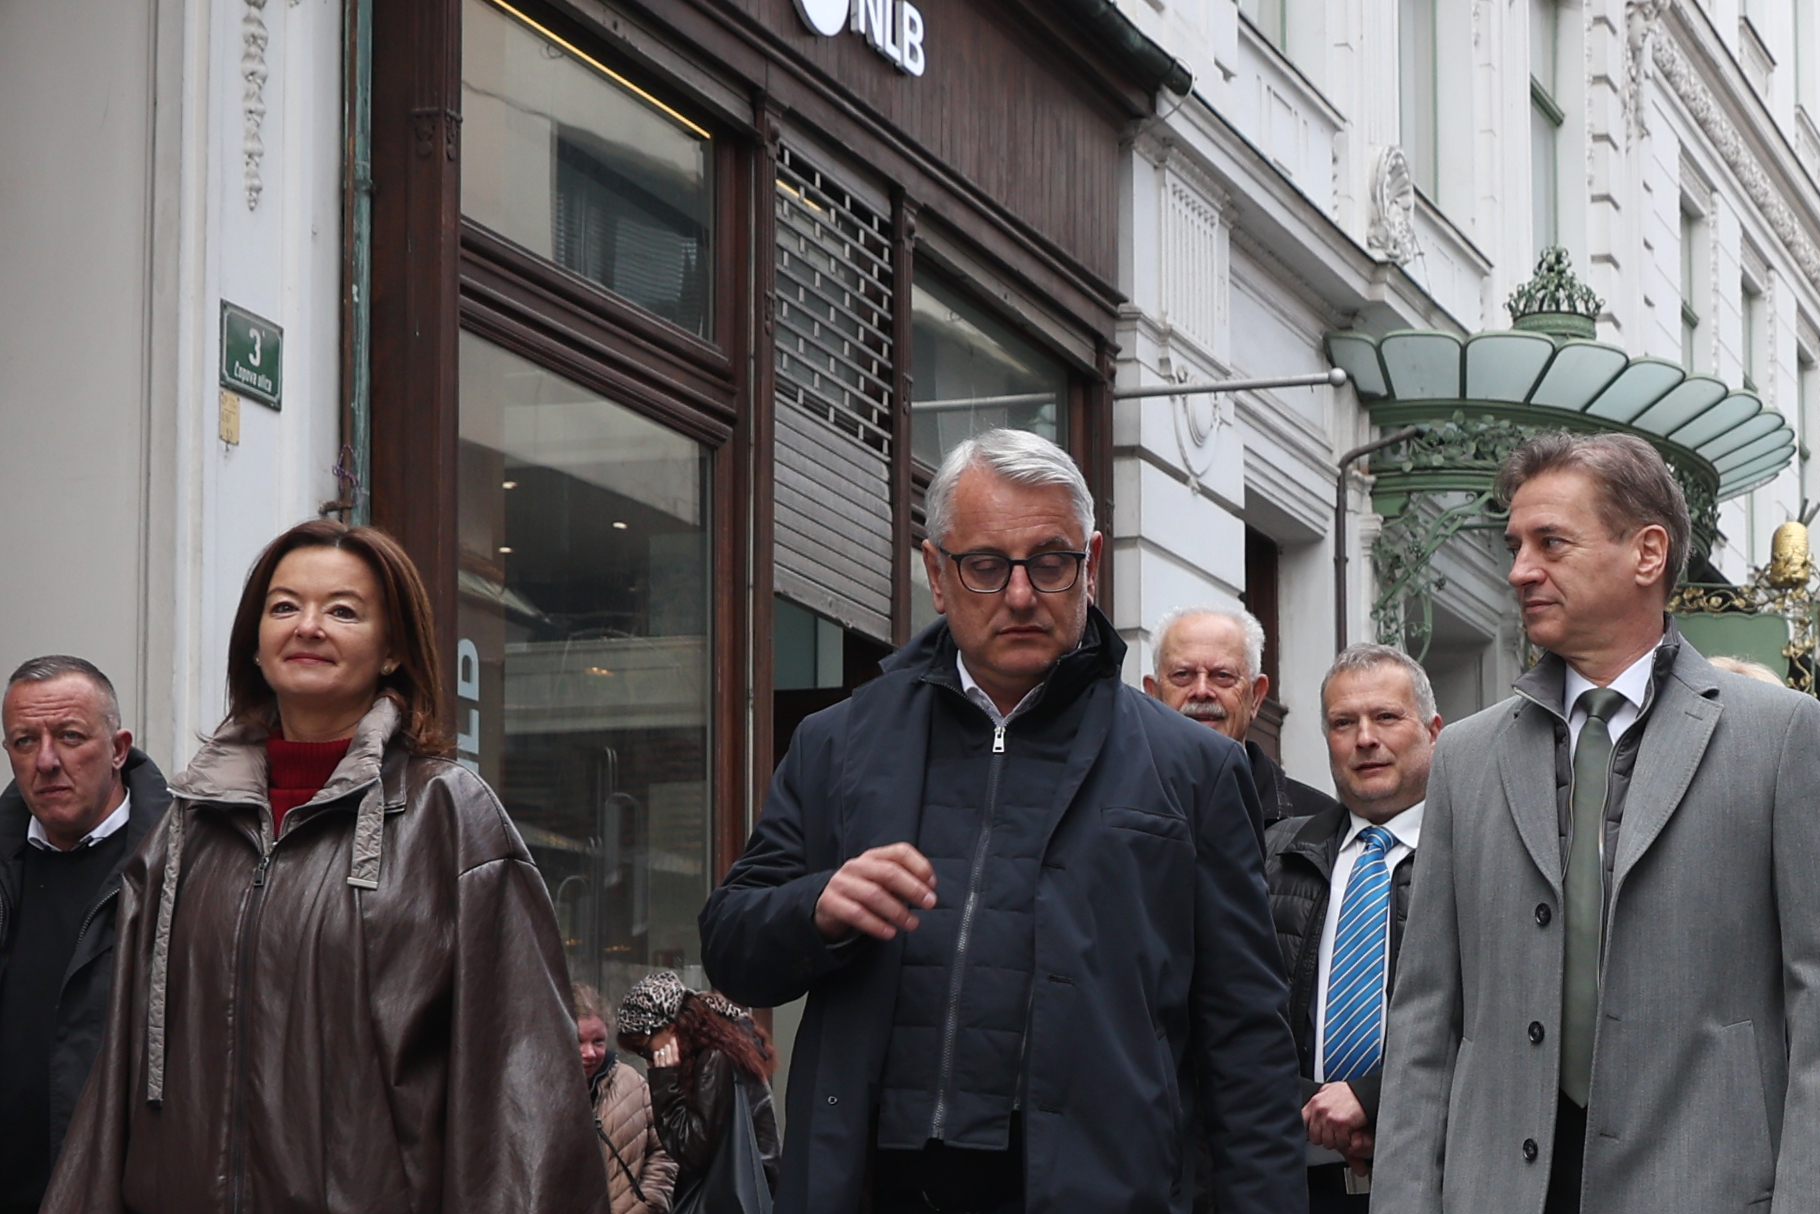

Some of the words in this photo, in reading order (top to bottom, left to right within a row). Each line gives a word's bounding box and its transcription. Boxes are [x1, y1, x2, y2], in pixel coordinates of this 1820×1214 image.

[856, 0, 926, 77] NLB
[249, 328, 261, 367] 3
[258, 374, 272, 392] ulica
